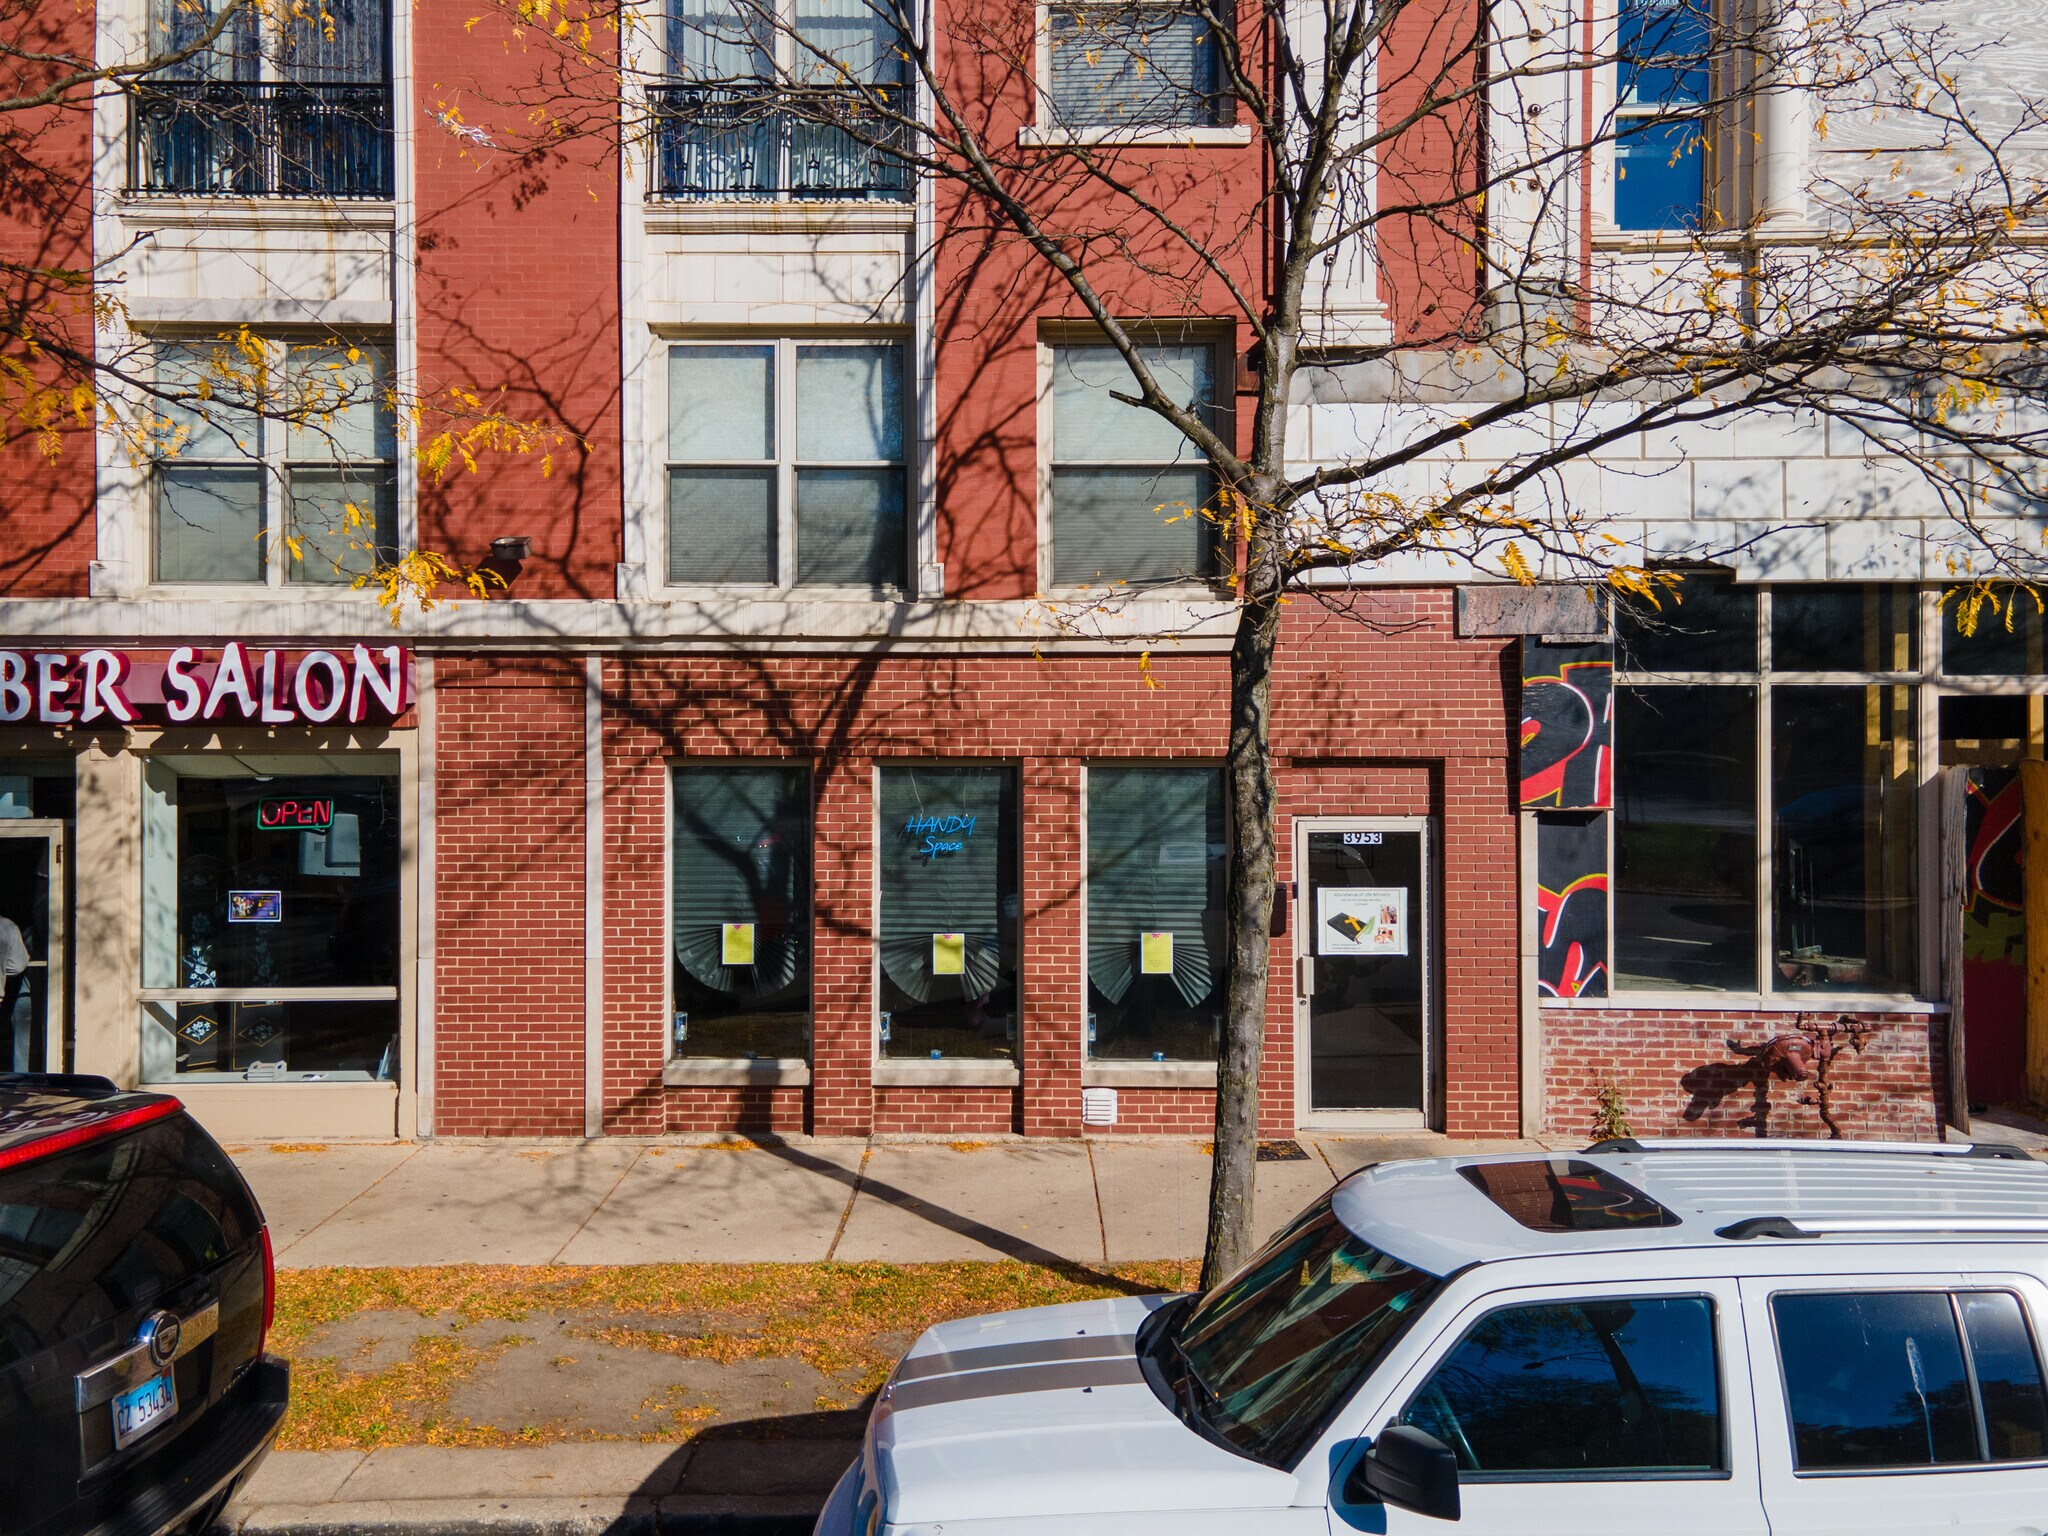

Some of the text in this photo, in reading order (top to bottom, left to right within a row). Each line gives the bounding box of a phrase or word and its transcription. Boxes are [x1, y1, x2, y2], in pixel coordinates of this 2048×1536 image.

[166, 642, 402, 723] SALON
[261, 801, 331, 825] OPEN
[906, 816, 976, 835] HANDY
[919, 836, 963, 859] Space
[1345, 832, 1381, 843] 3953
[117, 1404, 132, 1436] CZ
[138, 1382, 172, 1421] 53434
